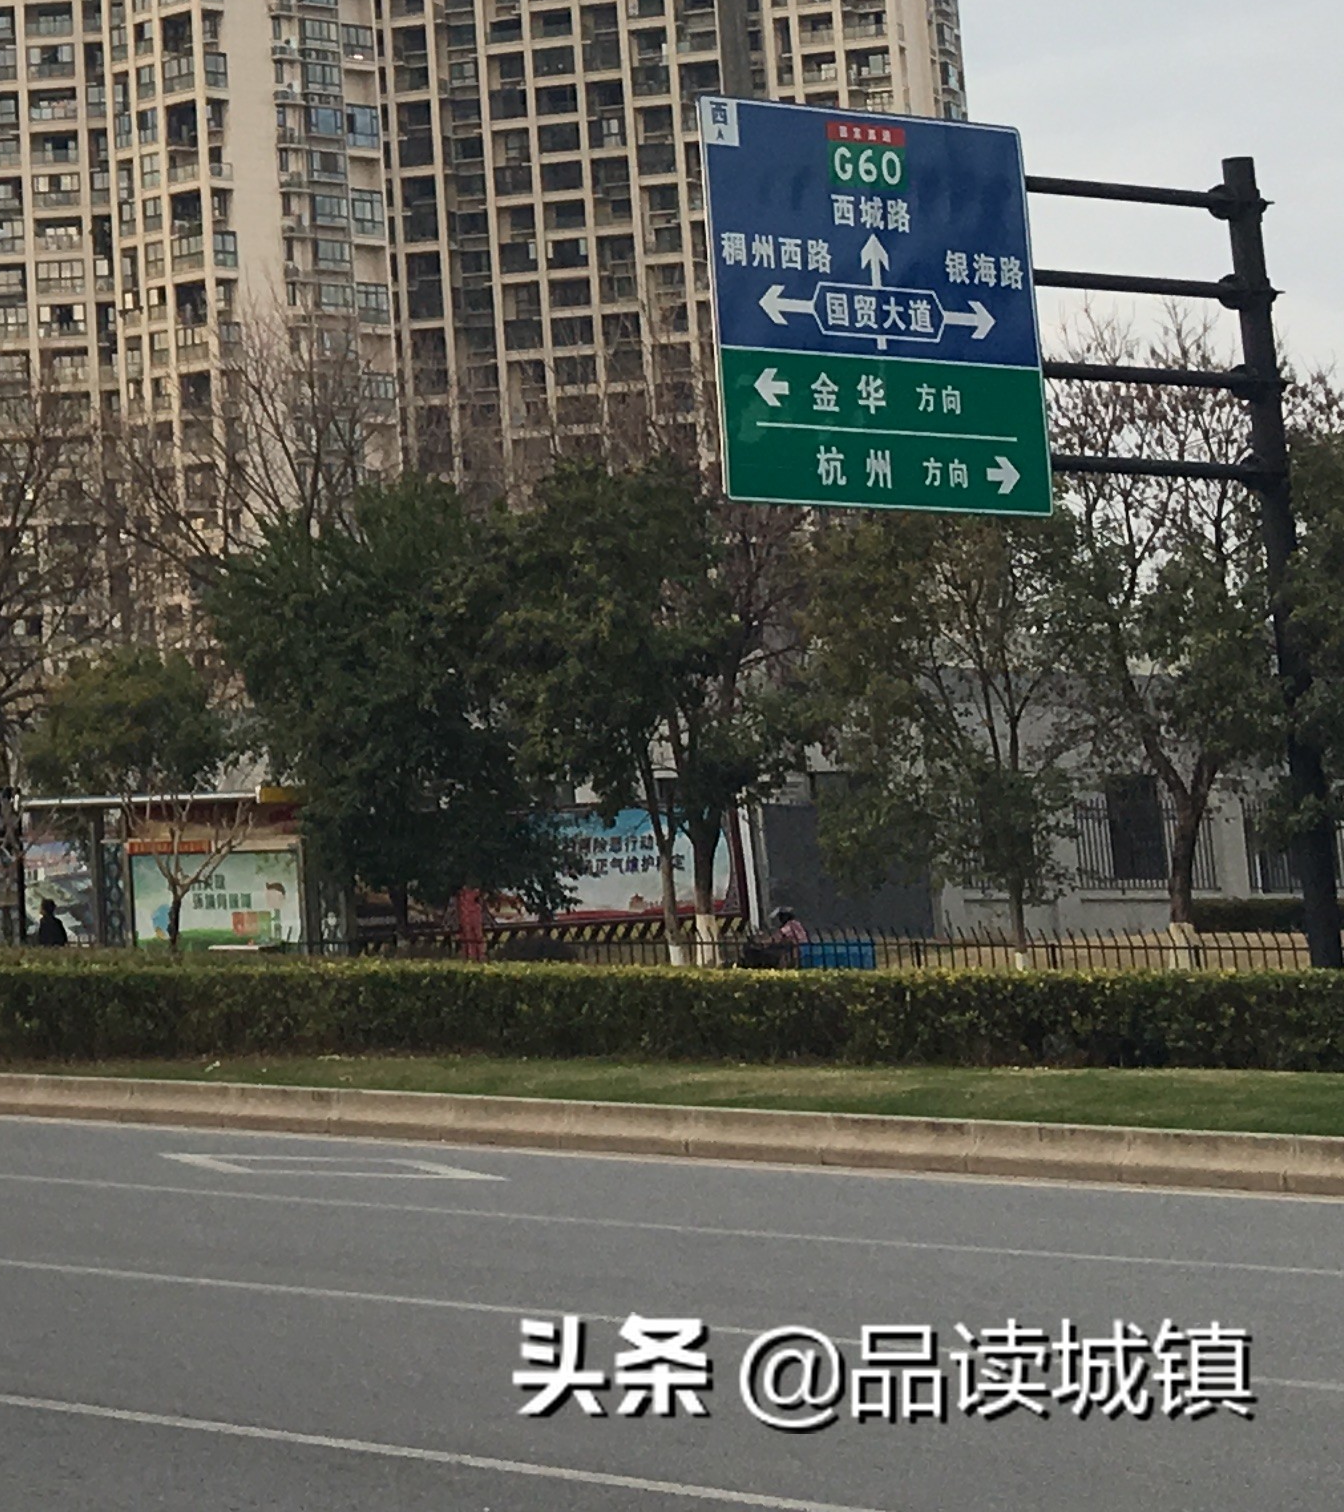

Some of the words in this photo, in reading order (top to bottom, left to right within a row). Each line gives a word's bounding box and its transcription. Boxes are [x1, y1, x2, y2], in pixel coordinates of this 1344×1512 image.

[709, 100, 729, 126] 西
[834, 146, 902, 186] G60
[830, 193, 911, 234] 西城路
[720, 231, 832, 275] 稠州西路
[944, 249, 1024, 291] 银海路
[824, 292, 935, 334] 国贸大道
[810, 371, 888, 415] 金华
[915, 382, 962, 416] 方向
[816, 444, 893, 489] 杭州
[922, 456, 969, 489] 方向
